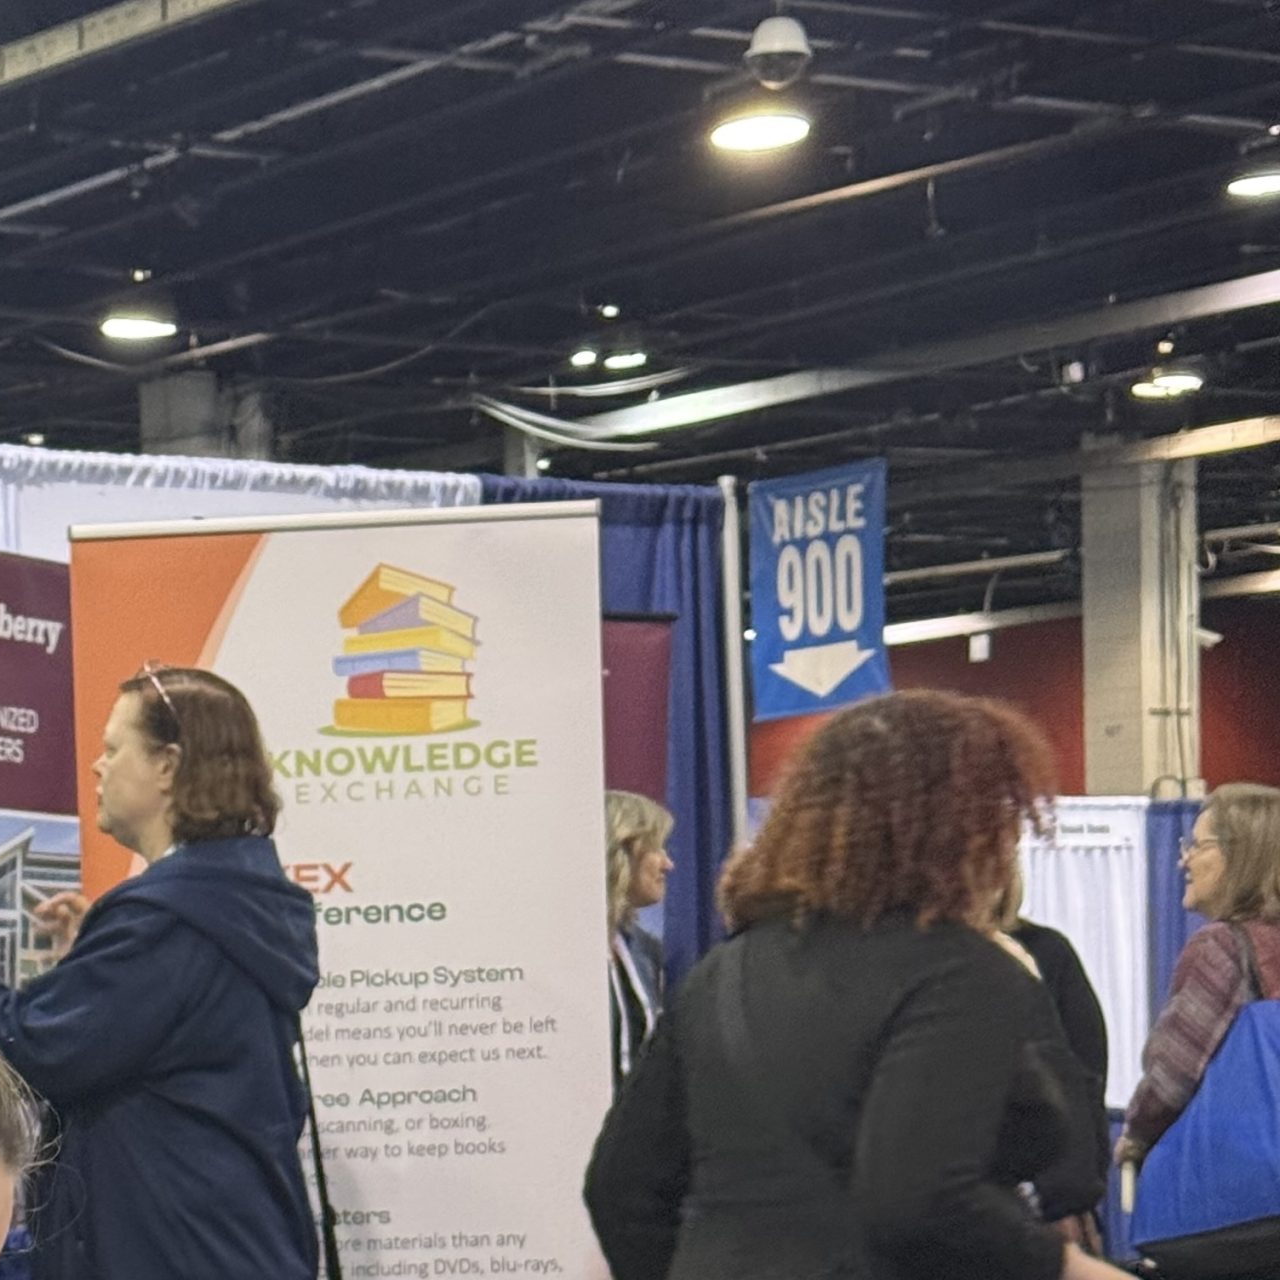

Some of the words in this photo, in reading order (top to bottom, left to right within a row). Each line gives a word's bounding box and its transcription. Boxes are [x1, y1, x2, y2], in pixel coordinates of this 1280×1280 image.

[771, 483, 867, 544] AISLE
[777, 534, 863, 642] 900
[270, 739, 539, 778] KNOWLEDGE
[294, 774, 511, 804] EXCHANGE
[286, 861, 354, 894] EX
[350, 968, 429, 989] Pickup
[433, 965, 524, 987] System
[318, 998, 379, 1018] regular
[384, 997, 416, 1013] and
[422, 994, 503, 1012] recurring
[335, 1027, 391, 1040] means
[397, 1019, 442, 1041] you'll
[448, 1022, 497, 1037] never
[502, 1017, 523, 1034] be
[529, 1016, 557, 1033] left
[346, 1051, 378, 1069] you
[383, 1050, 412, 1065] can
[418, 1047, 475, 1066] expect
[481, 1048, 500, 1062] us
[358, 1085, 477, 1110] Approach
[405, 1116, 423, 1131] or
[344, 1145, 378, 1162] way
[384, 1142, 402, 1158] to
[406, 1140, 449, 1159] keep
[454, 1138, 506, 1155] books
[334, 1210, 391, 1226] ters
[367, 1235, 446, 1251] materials
[451, 1232, 490, 1248] than
[496, 1233, 526, 1250] any
[351, 1261, 429, 1279] including
[434, 1258, 484, 1277] DVDs,
[490, 1256, 563, 1275] blu-rays,
